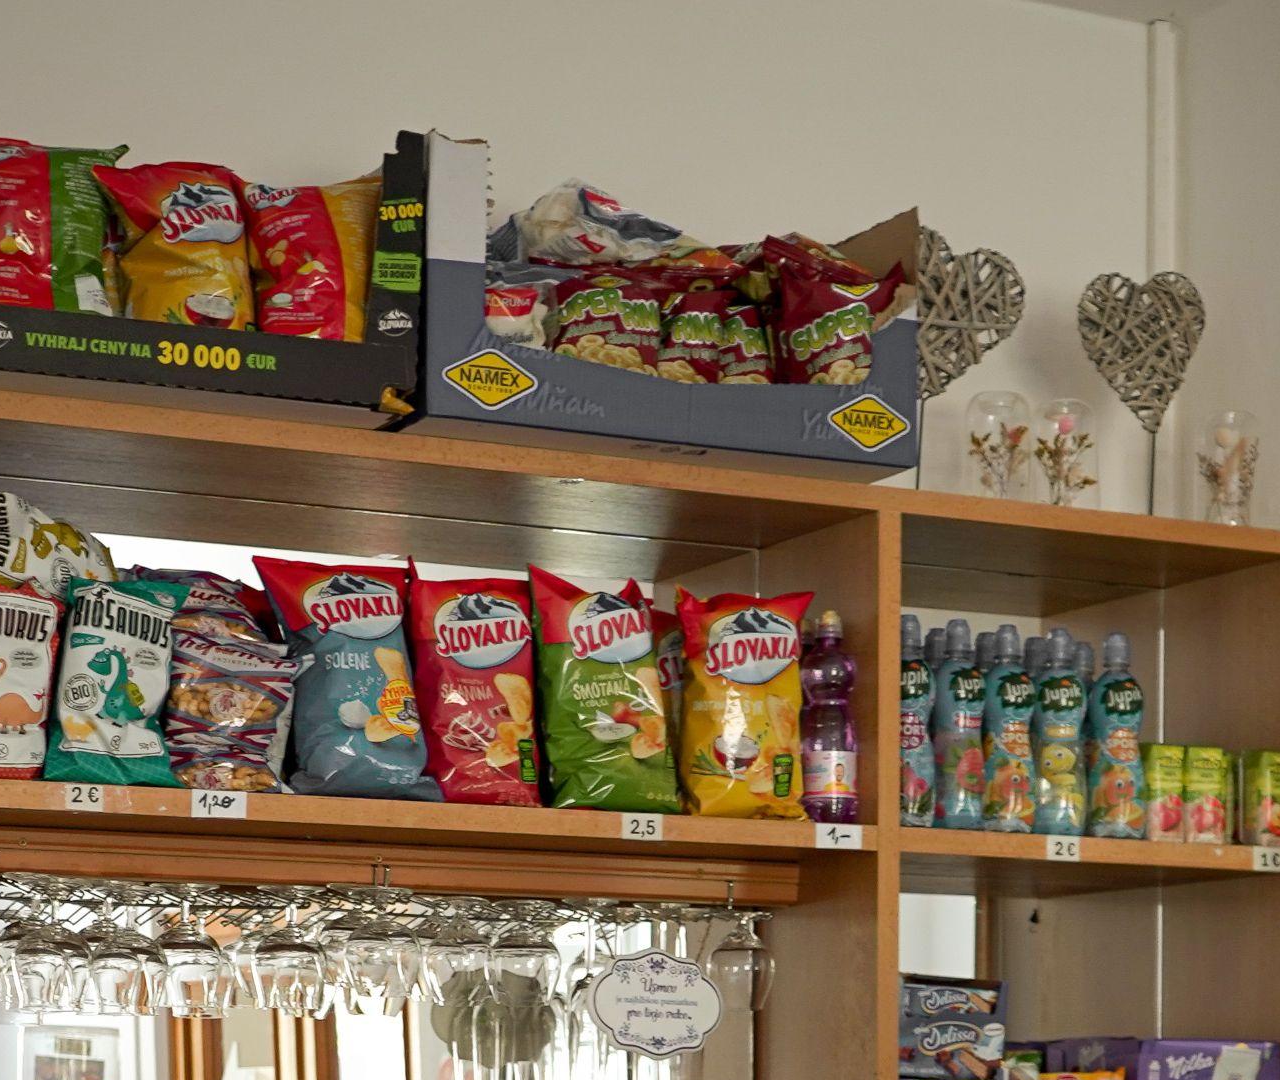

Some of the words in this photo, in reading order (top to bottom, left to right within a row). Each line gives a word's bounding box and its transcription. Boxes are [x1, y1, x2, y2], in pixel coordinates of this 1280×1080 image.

[161, 201, 244, 243] SLOVAKIA
[378, 203, 396, 221] 30
[397, 202, 424, 219] 000
[560, 288, 622, 326] UPER
[621, 299, 660, 332] RIN
[378, 317, 413, 332] SLOVAKIA
[790, 302, 872, 361] SUPER
[25, 332, 87, 351] VYHRAJ
[89, 338, 128, 355] CENY
[129, 343, 152, 358] NA
[156, 340, 192, 367] 30
[193, 344, 241, 371] 000
[459, 367, 520, 388] NAMEX
[842, 412, 896, 432] NAMEX
[71, 594, 172, 648] BIOSAURUS
[310, 595, 403, 635] SLOVAKIA
[436, 620, 532, 658] SLOVAKIA
[571, 610, 650, 659] SLOVAK
[324, 651, 371, 671] SOLENÉ
[706, 638, 801, 675] SLOVAKIA
[71, 685, 91, 701] BIO
[440, 682, 493, 702] SLANINA
[572, 678, 631, 701] SMOTANA
[71, 787, 82, 803] 2
[87, 786, 100, 803] €
[630, 819, 656, 838] 2,5
[1054, 841, 1066, 857] 2
[1066, 841, 1078, 857] €
[1261, 853, 1270, 867] 1
[922, 1027, 979, 1051] Delissa
[1167, 1052, 1216, 1080] Milka
